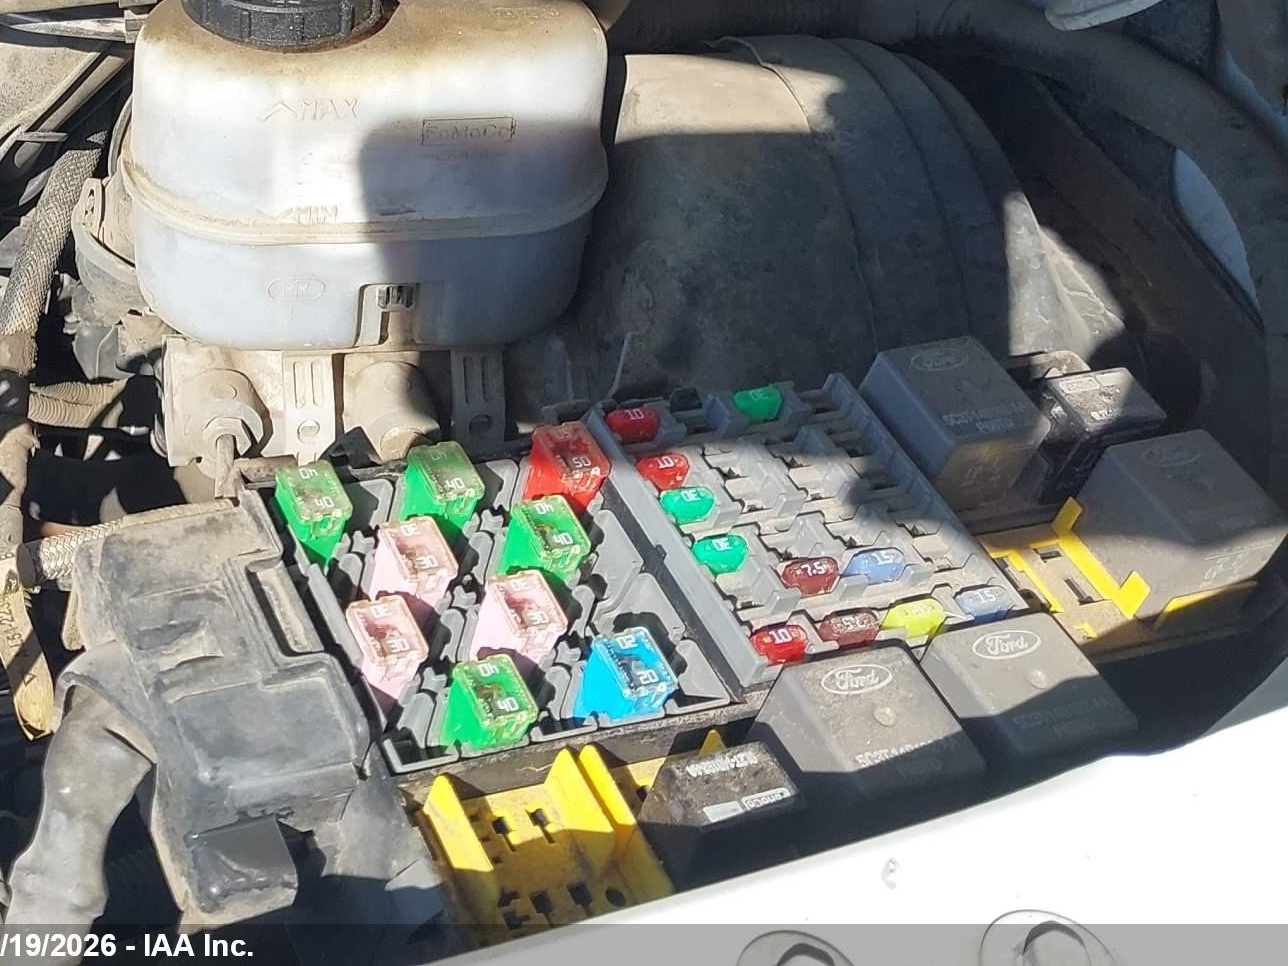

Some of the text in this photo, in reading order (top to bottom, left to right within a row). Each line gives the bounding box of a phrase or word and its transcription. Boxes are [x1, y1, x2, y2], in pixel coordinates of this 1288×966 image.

[301, 97, 358, 121] MAX
[624, 408, 645, 420] 10
[572, 456, 592, 468] 50
[655, 456, 675, 469] 10
[446, 477, 465, 490] 40
[314, 496, 335, 509] 40
[552, 533, 574, 546] 40
[416, 556, 438, 569] 30
[871, 549, 894, 565] 15
[801, 560, 827, 576] 7.5
[975, 589, 997, 603] 15
[528, 610, 550, 624] 30
[768, 628, 792, 644] 10
[388, 638, 410, 652] 30
[637, 669, 660, 685] 20
[495, 696, 519, 712] 40
